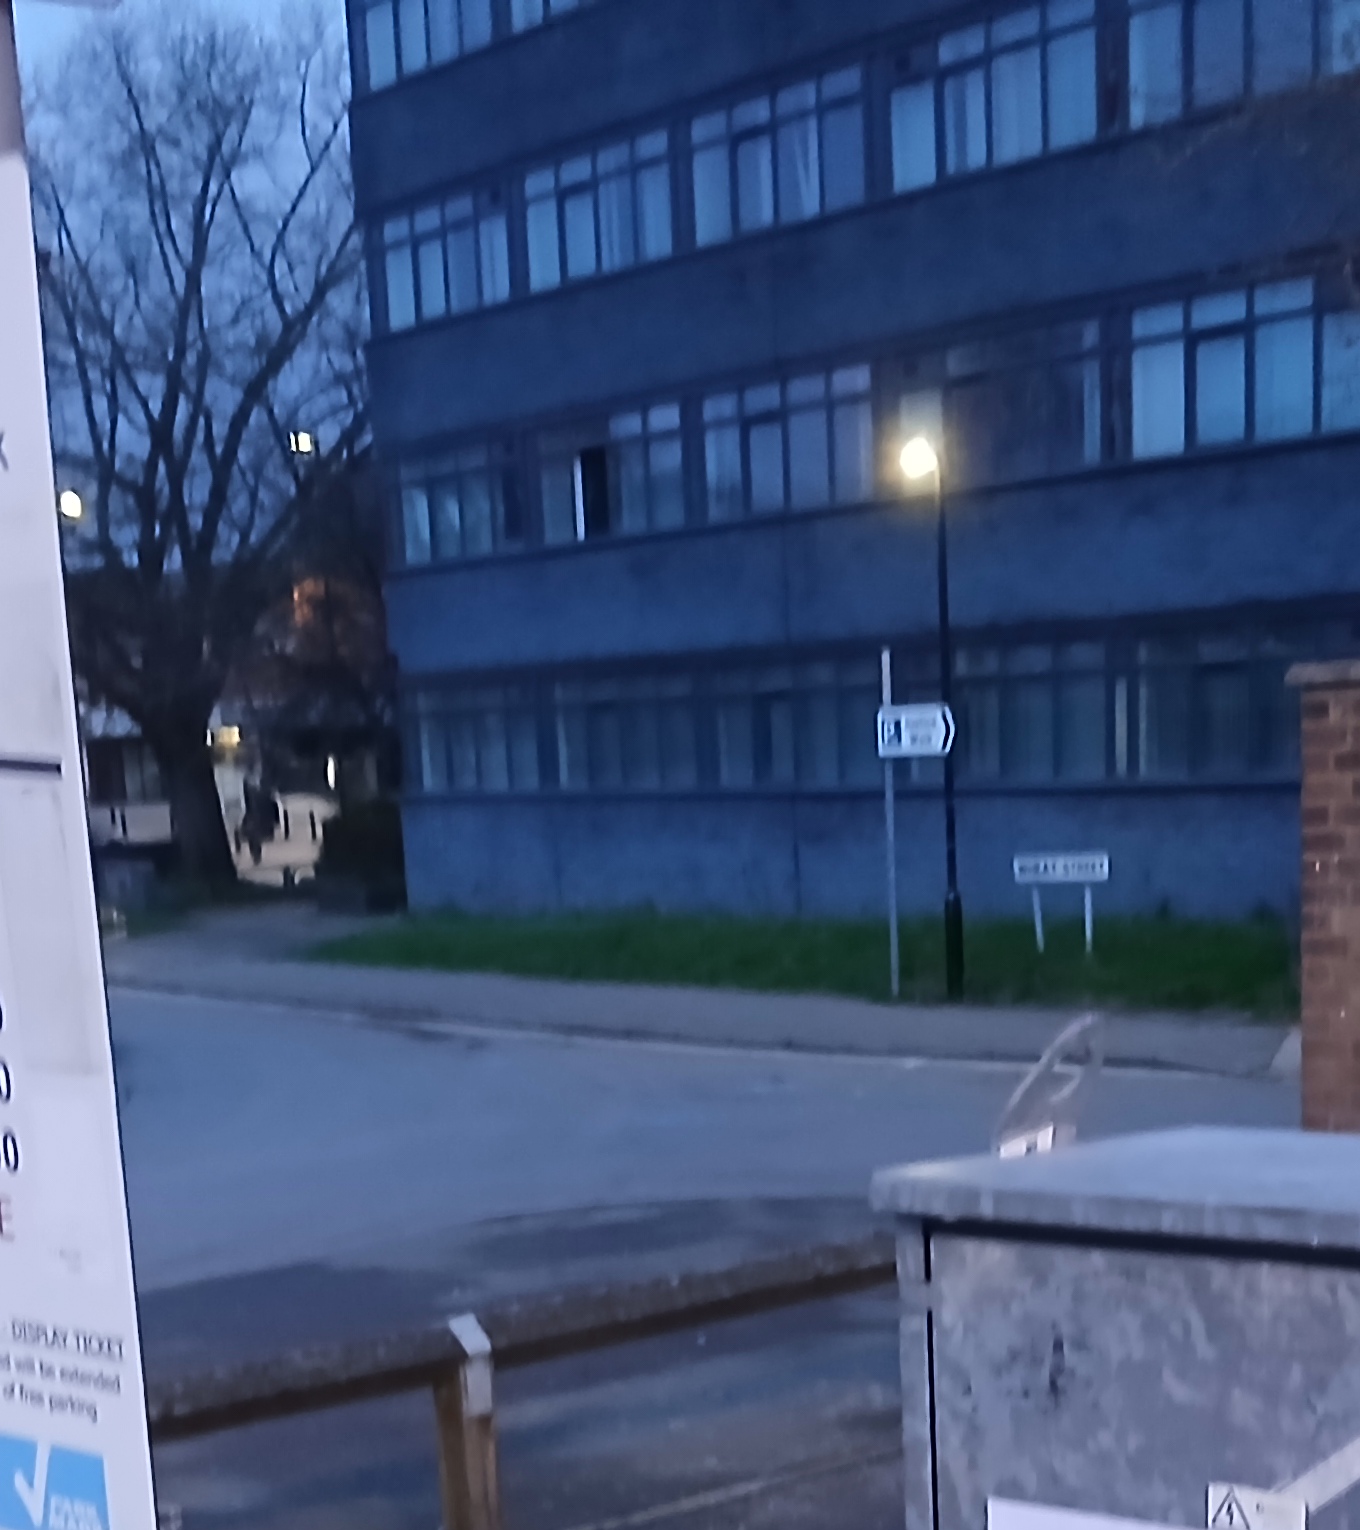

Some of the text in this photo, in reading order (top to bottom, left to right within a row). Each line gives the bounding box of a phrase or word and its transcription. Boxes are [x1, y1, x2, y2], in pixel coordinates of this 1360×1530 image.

[11, 1318, 69, 1351] DISPLAY
[73, 1332, 123, 1361] TICKET
[49, 1395, 98, 1424] parking
